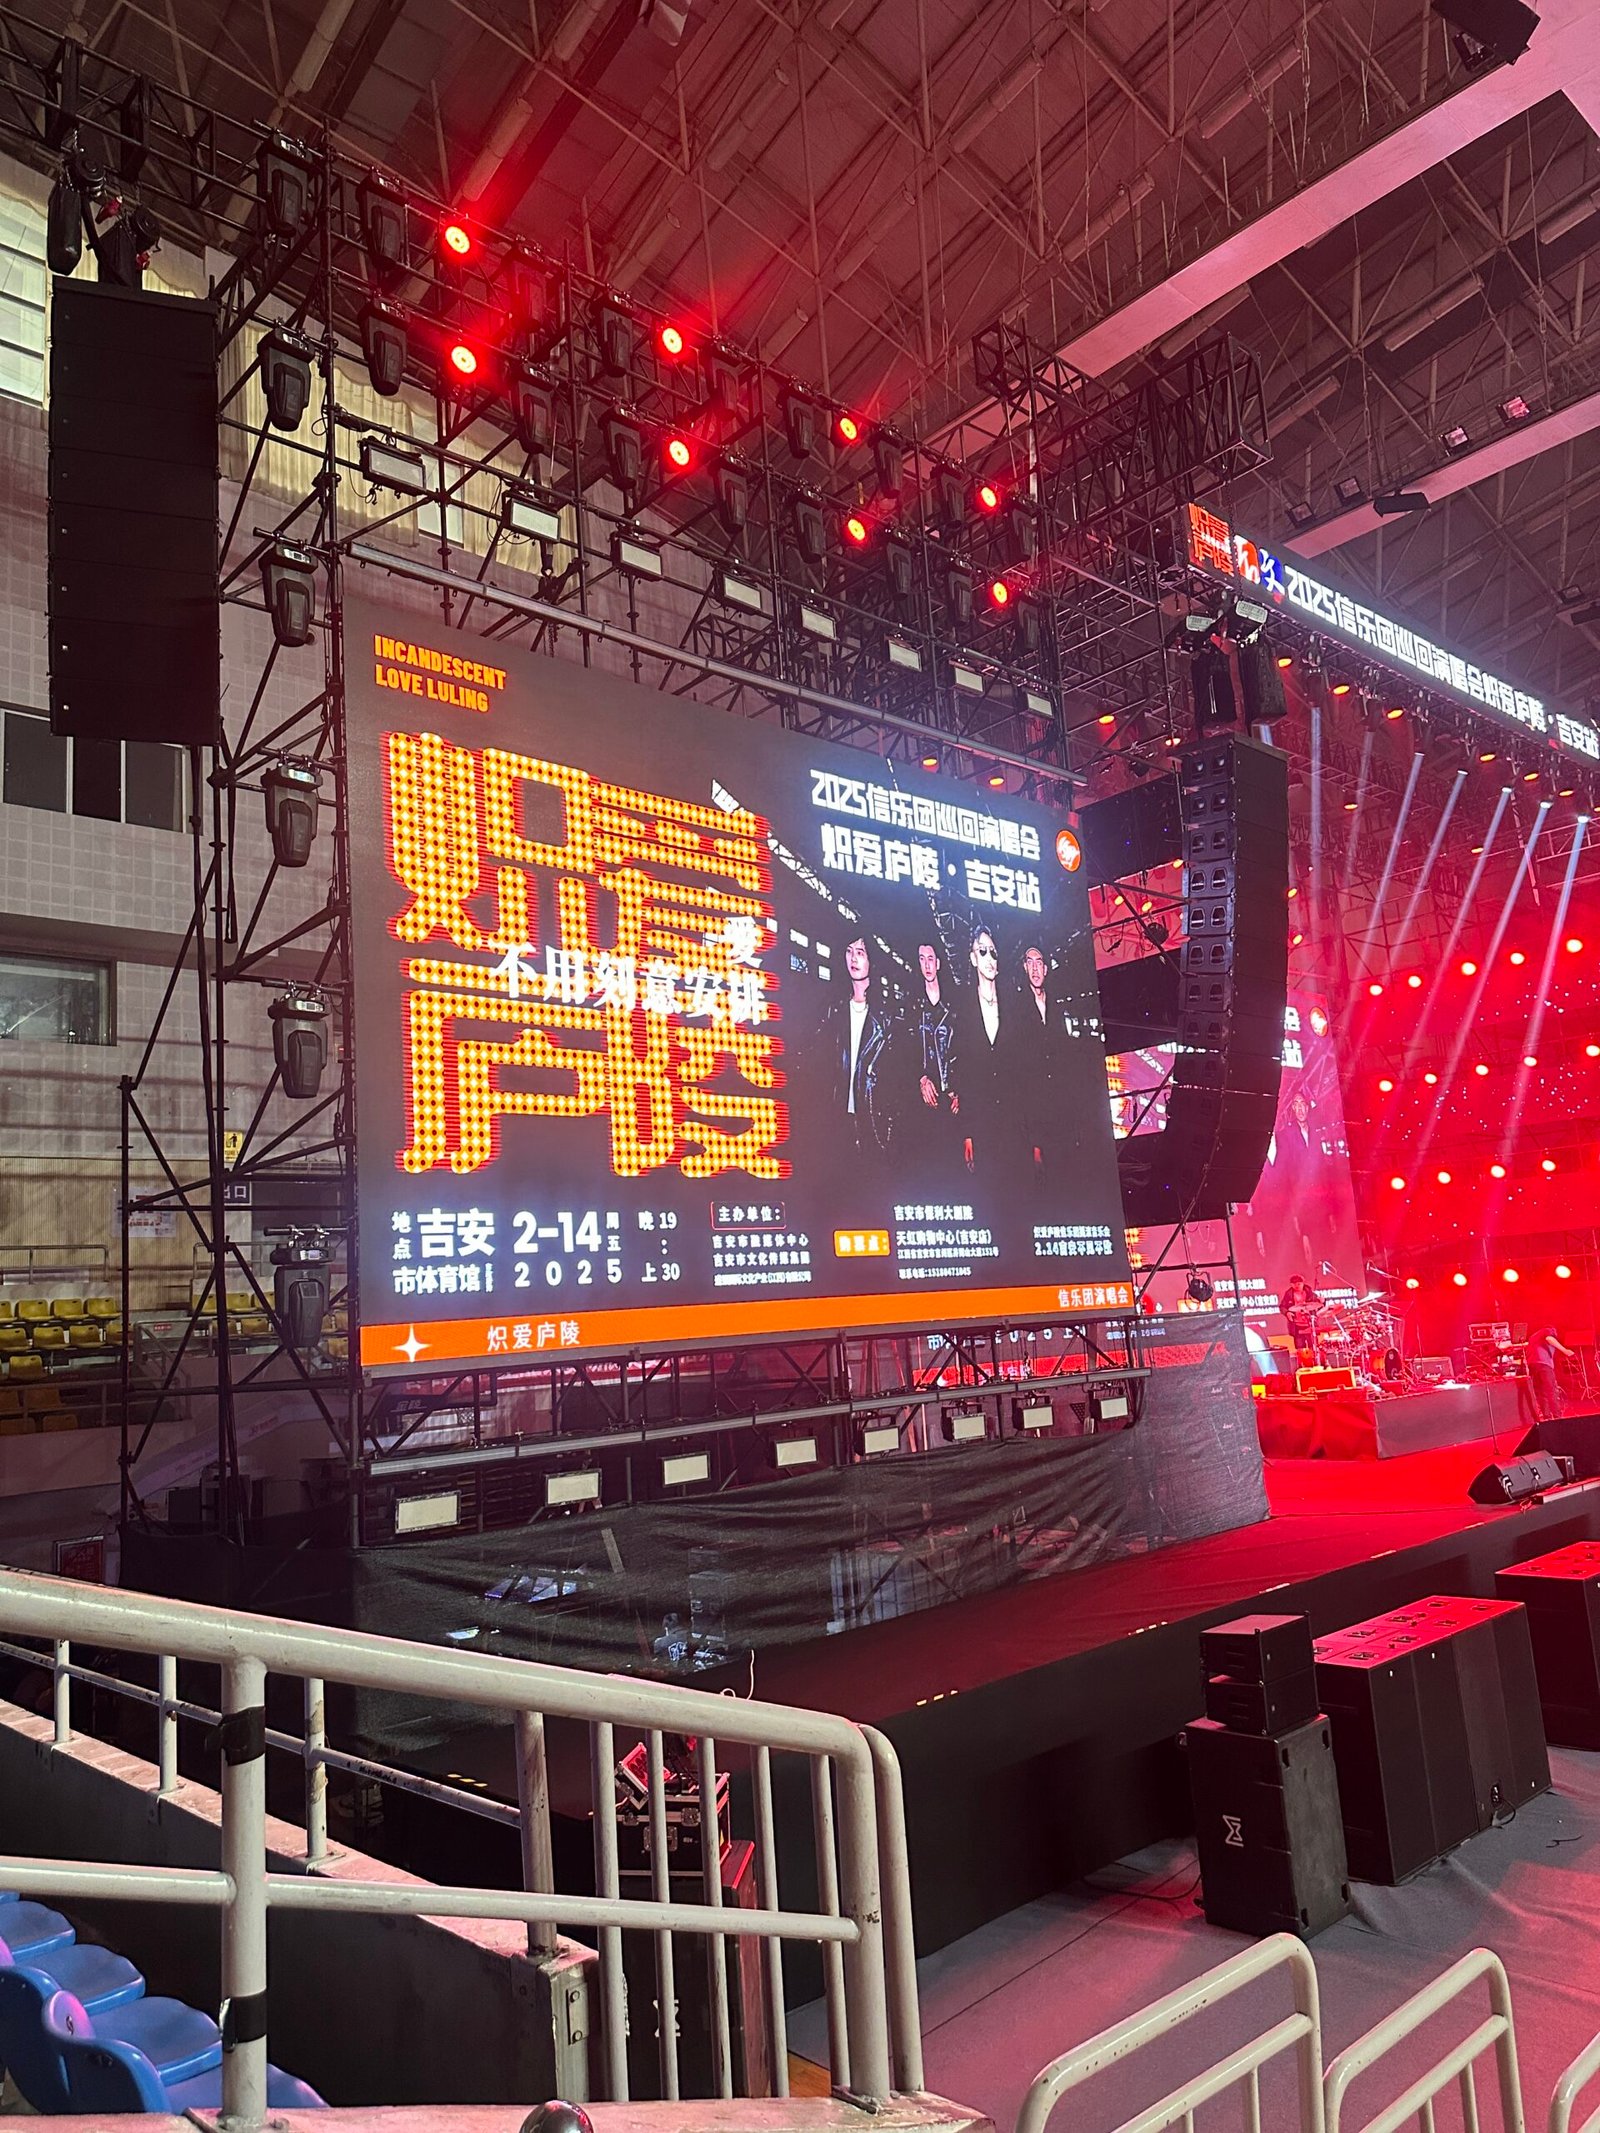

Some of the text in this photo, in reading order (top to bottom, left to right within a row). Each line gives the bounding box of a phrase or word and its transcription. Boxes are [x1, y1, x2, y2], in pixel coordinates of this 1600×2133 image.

[373, 635, 507, 692] INCANDESCENT
[375, 663, 490, 713] LOVE LULING
[810, 768, 1041, 861] 2025信乐团巡回演唱会
[489, 944, 766, 1026] 不用刻意安排
[417, 1207, 495, 1258] 吉安
[393, 1264, 480, 1295] 市体育馆
[1058, 1287, 1129, 1308] 信乐团演唱会
[488, 1320, 581, 1352] 炽爱庐陵
